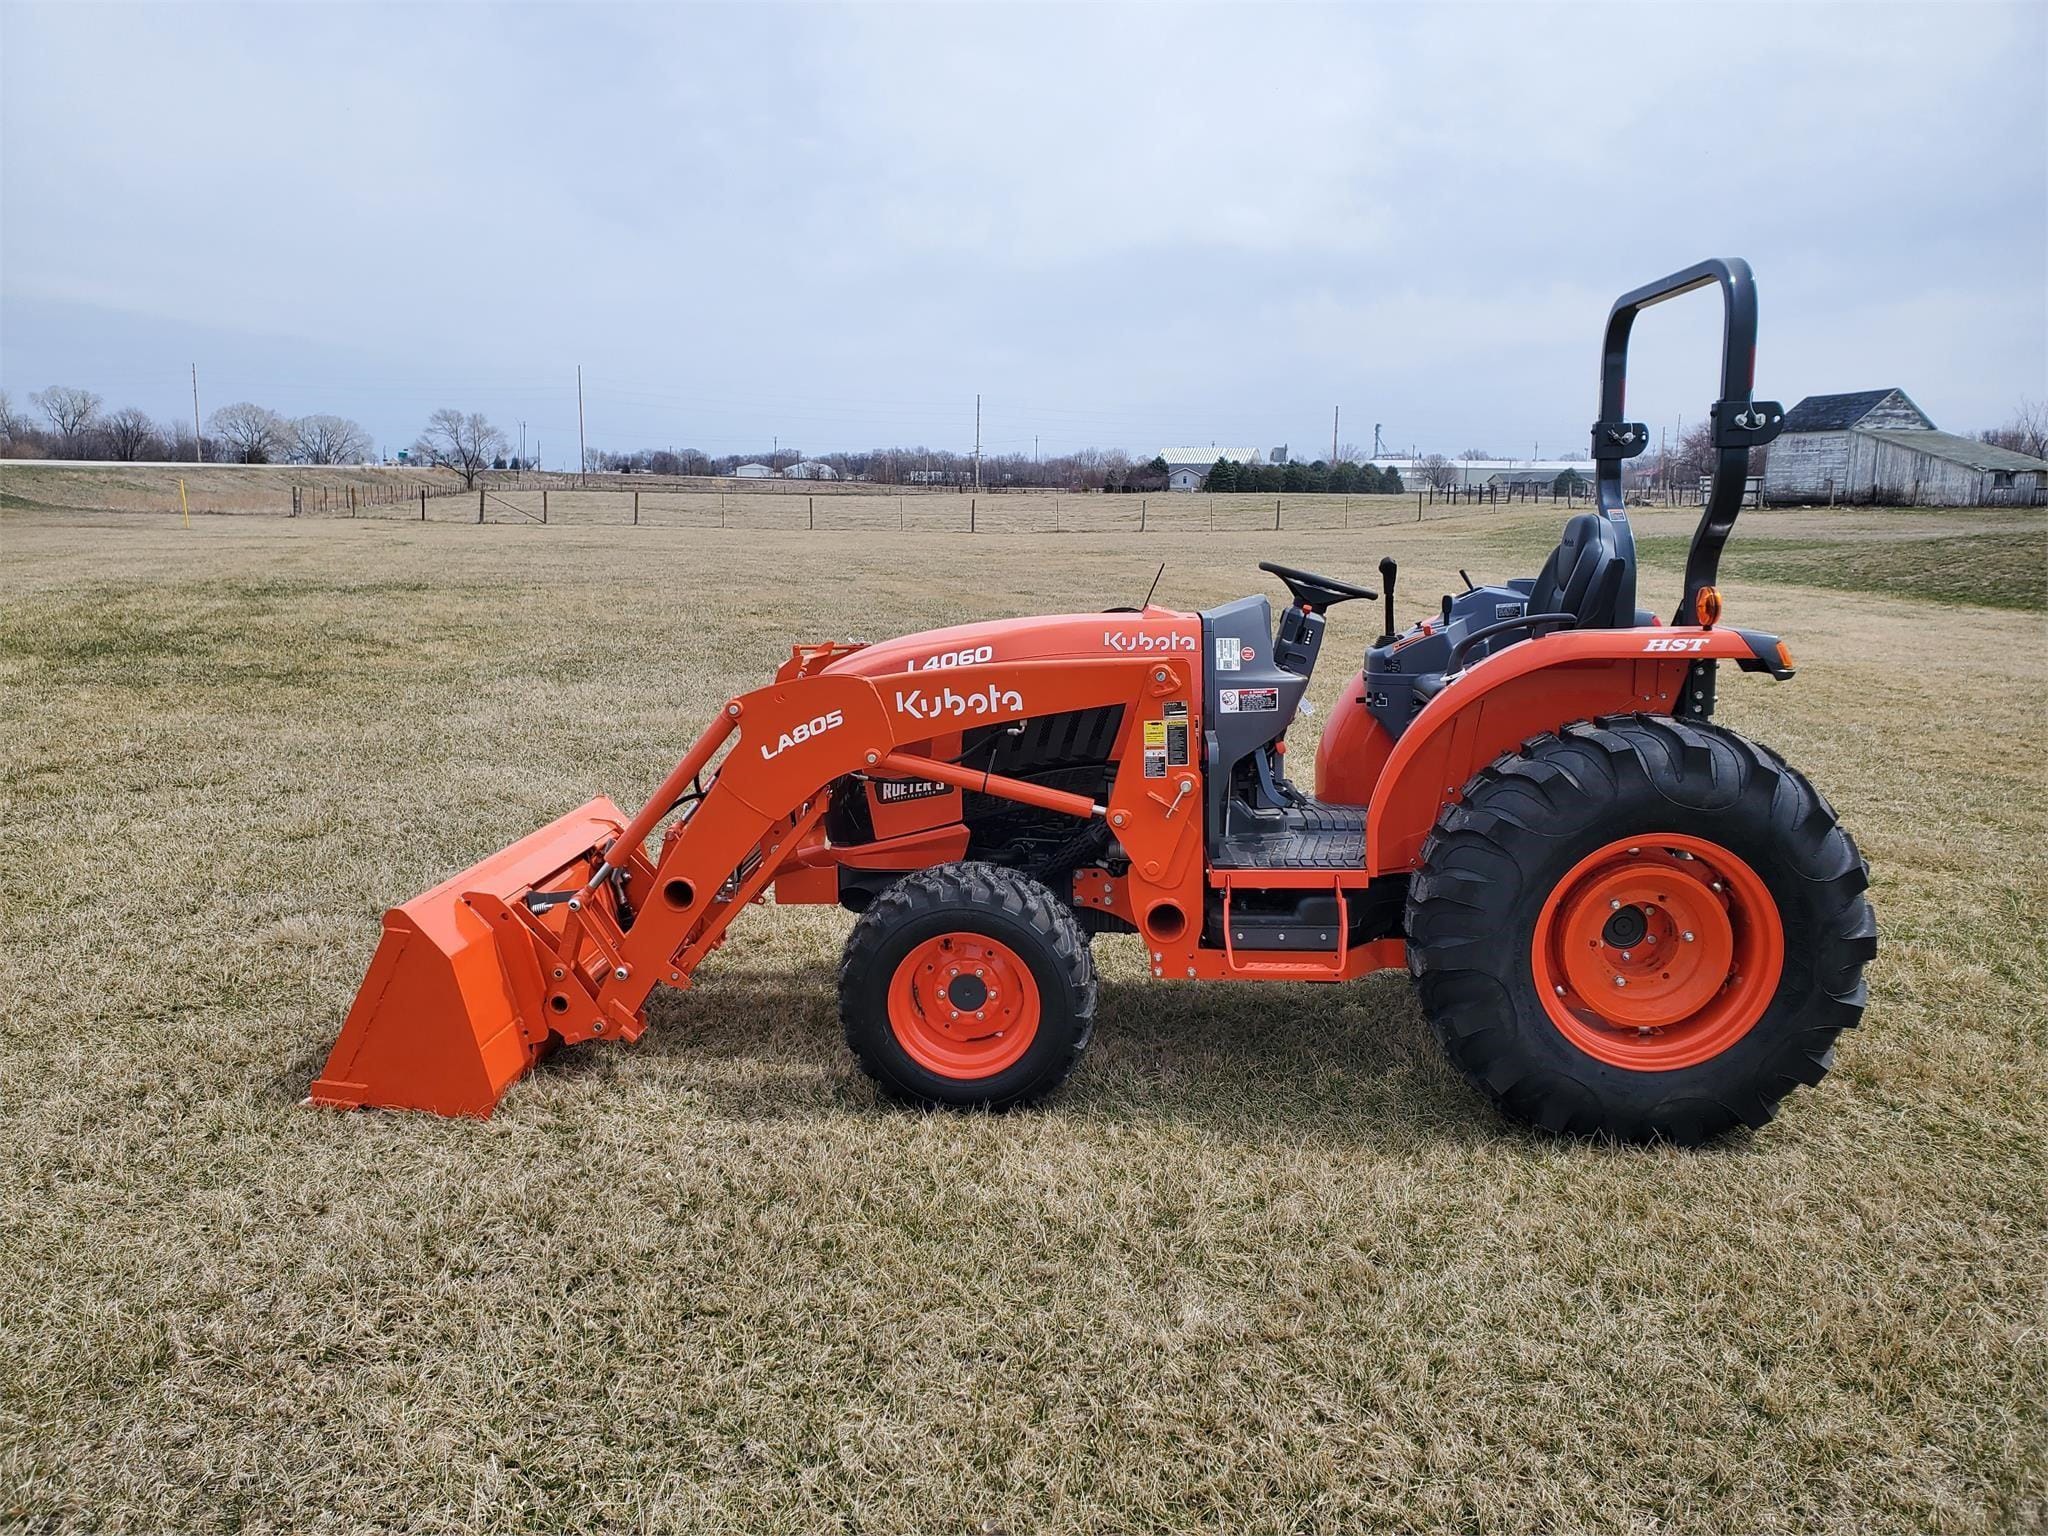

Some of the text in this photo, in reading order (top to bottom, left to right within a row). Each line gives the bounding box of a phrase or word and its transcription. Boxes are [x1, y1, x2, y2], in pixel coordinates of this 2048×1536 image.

[1104, 631, 1195, 651] Kubota
[1642, 638, 1710, 652] HST
[907, 646, 993, 672] L4060
[895, 684, 1023, 719] Kubota
[761, 709, 843, 760] LA805
